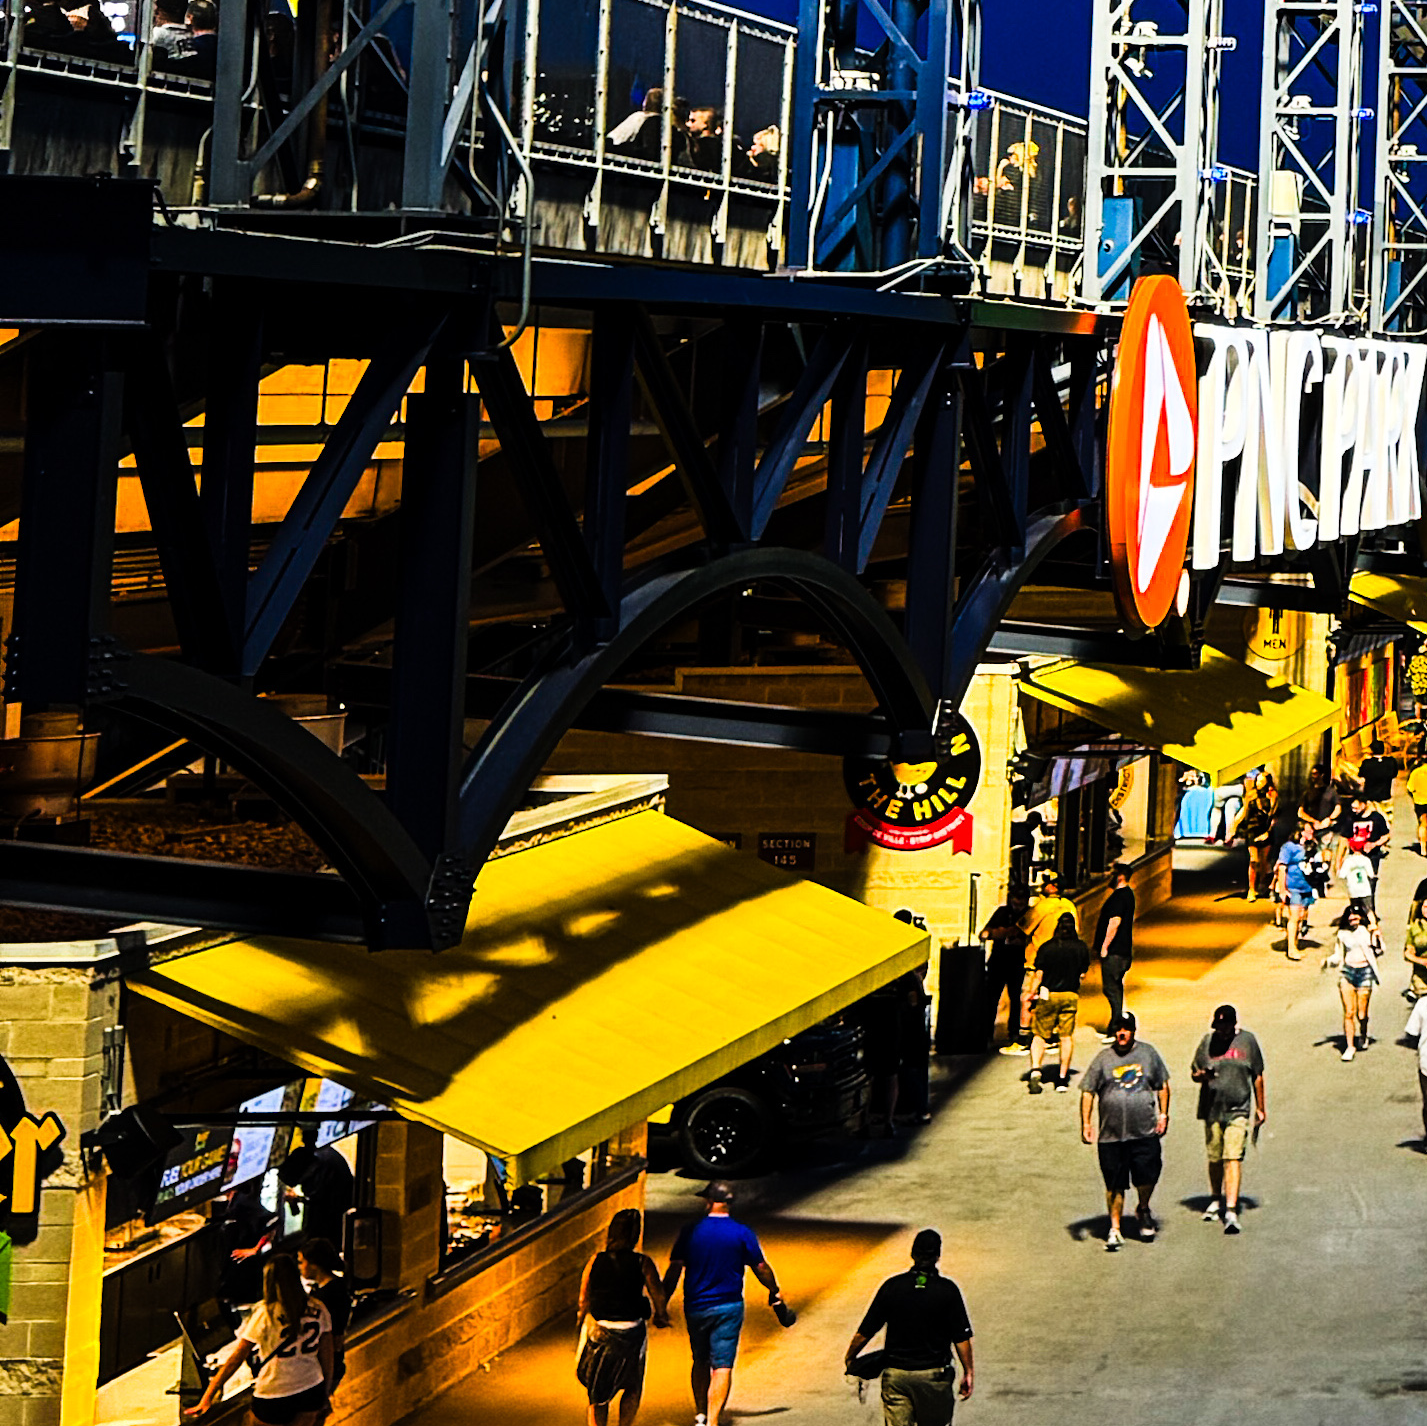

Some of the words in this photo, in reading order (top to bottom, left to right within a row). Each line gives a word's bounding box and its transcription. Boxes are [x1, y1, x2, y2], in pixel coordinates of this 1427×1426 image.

[1192, 322, 1324, 571] PNC
[1263, 638, 1287, 649] MEN
[859, 772, 904, 820] THE
[912, 776, 967, 822] HILL
[762, 839, 811, 849] SECTION
[774, 855, 797, 865] 145
